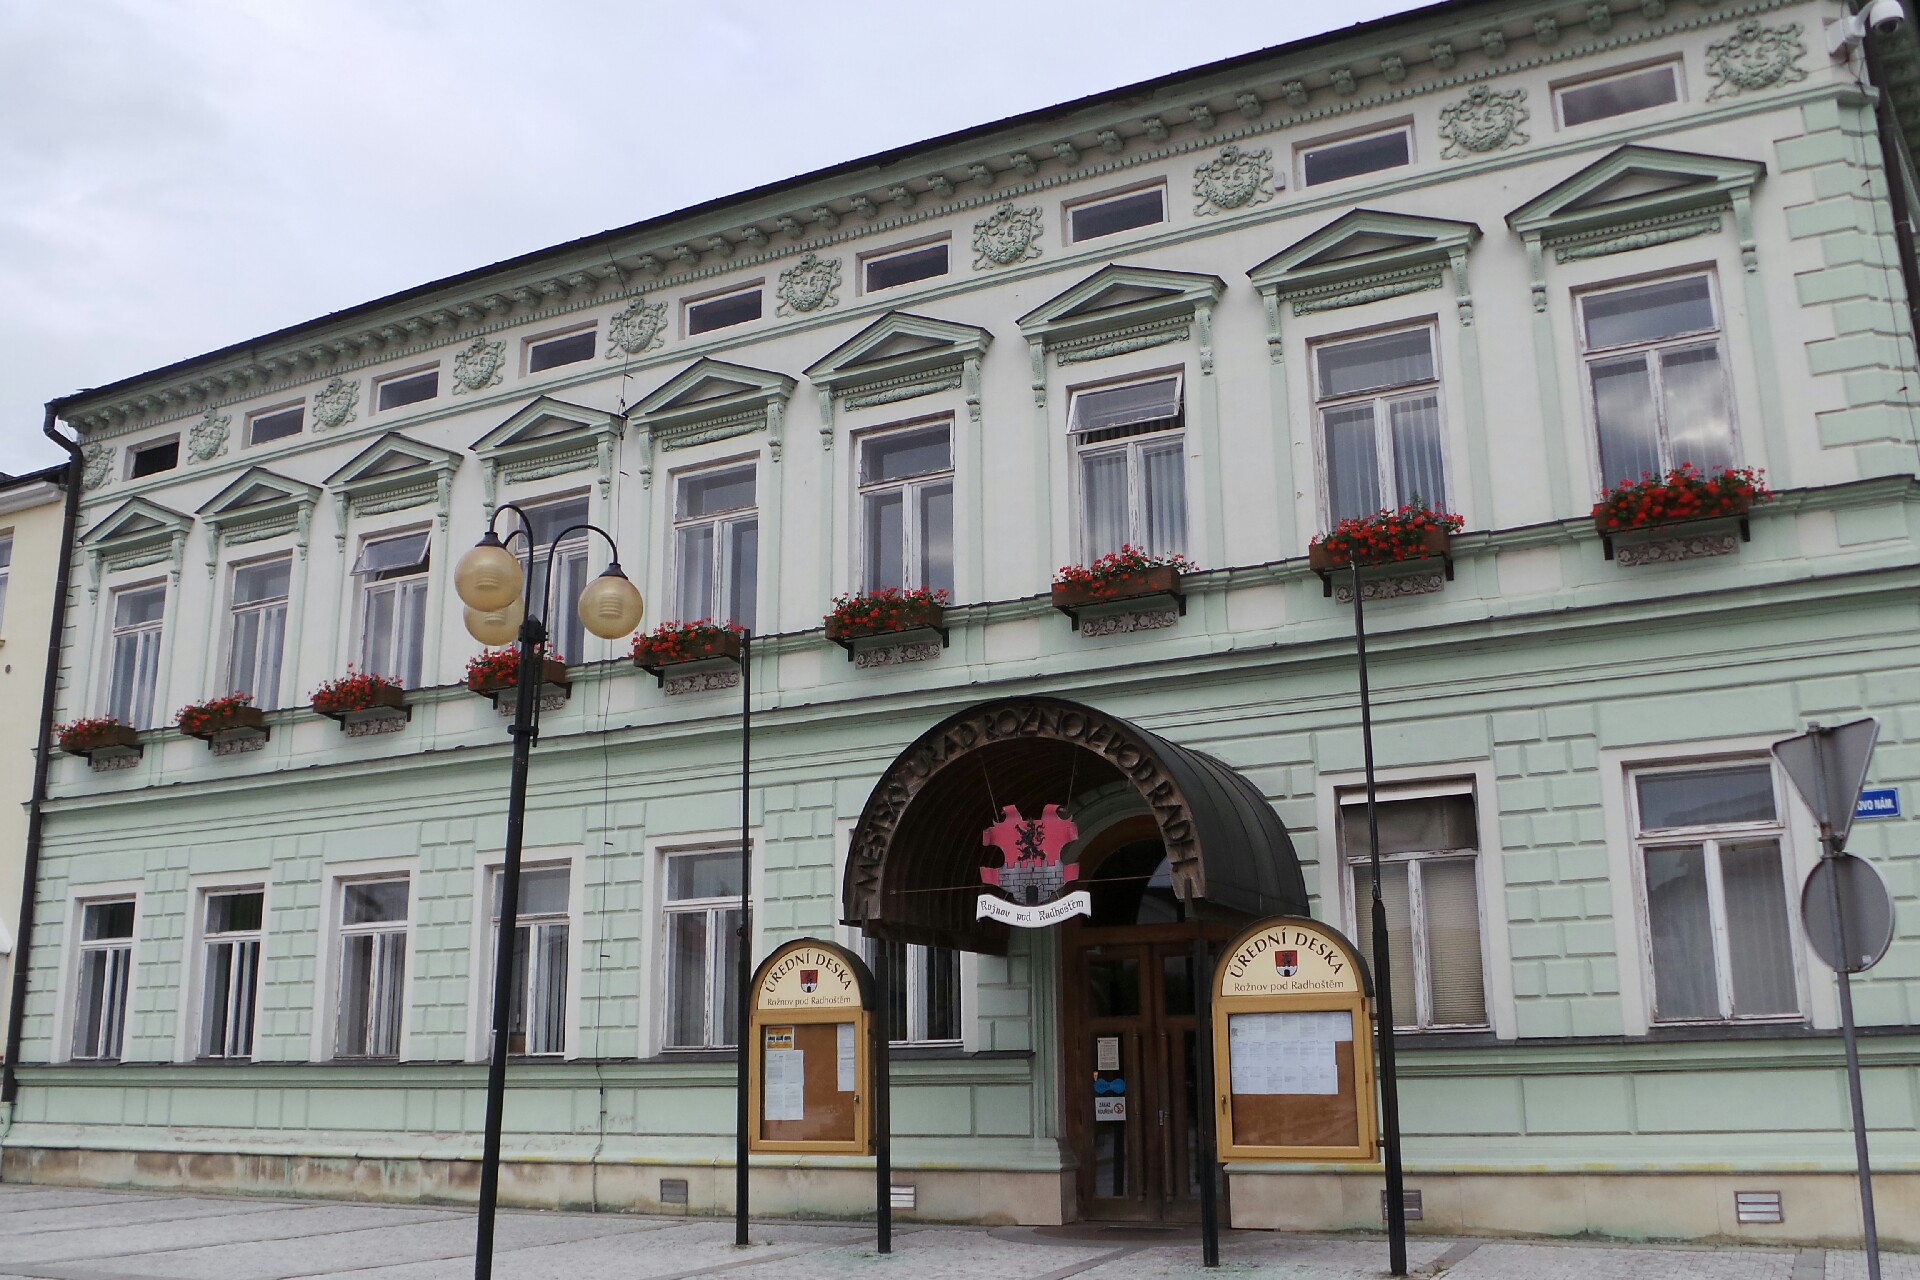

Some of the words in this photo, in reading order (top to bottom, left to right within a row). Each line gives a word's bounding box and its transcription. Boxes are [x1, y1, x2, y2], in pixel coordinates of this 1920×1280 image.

[984, 702, 1107, 743] ROŽNOV
[1103, 731, 1156, 781] POD
[1874, 796, 1895, 810] NÁM.
[980, 900, 1010, 917] Rožnov
[1016, 911, 1031, 922] pod
[1039, 899, 1084, 921] Radhoštěm
[1229, 927, 1286, 978] ÚŘEDNÍ
[1295, 932, 1344, 975] DESKA
[765, 949, 810, 993] ÚŘEDNÍ
[816, 953, 851, 990] DESKA
[1234, 982, 1267, 992] Rožnov
[1270, 981, 1288, 993] pod
[1291, 979, 1344, 990] Radhoštěm
[767, 998, 793, 1006] Rožnov
[795, 997, 808, 1007] pod
[811, 996, 851, 1005] Radhoštěm
